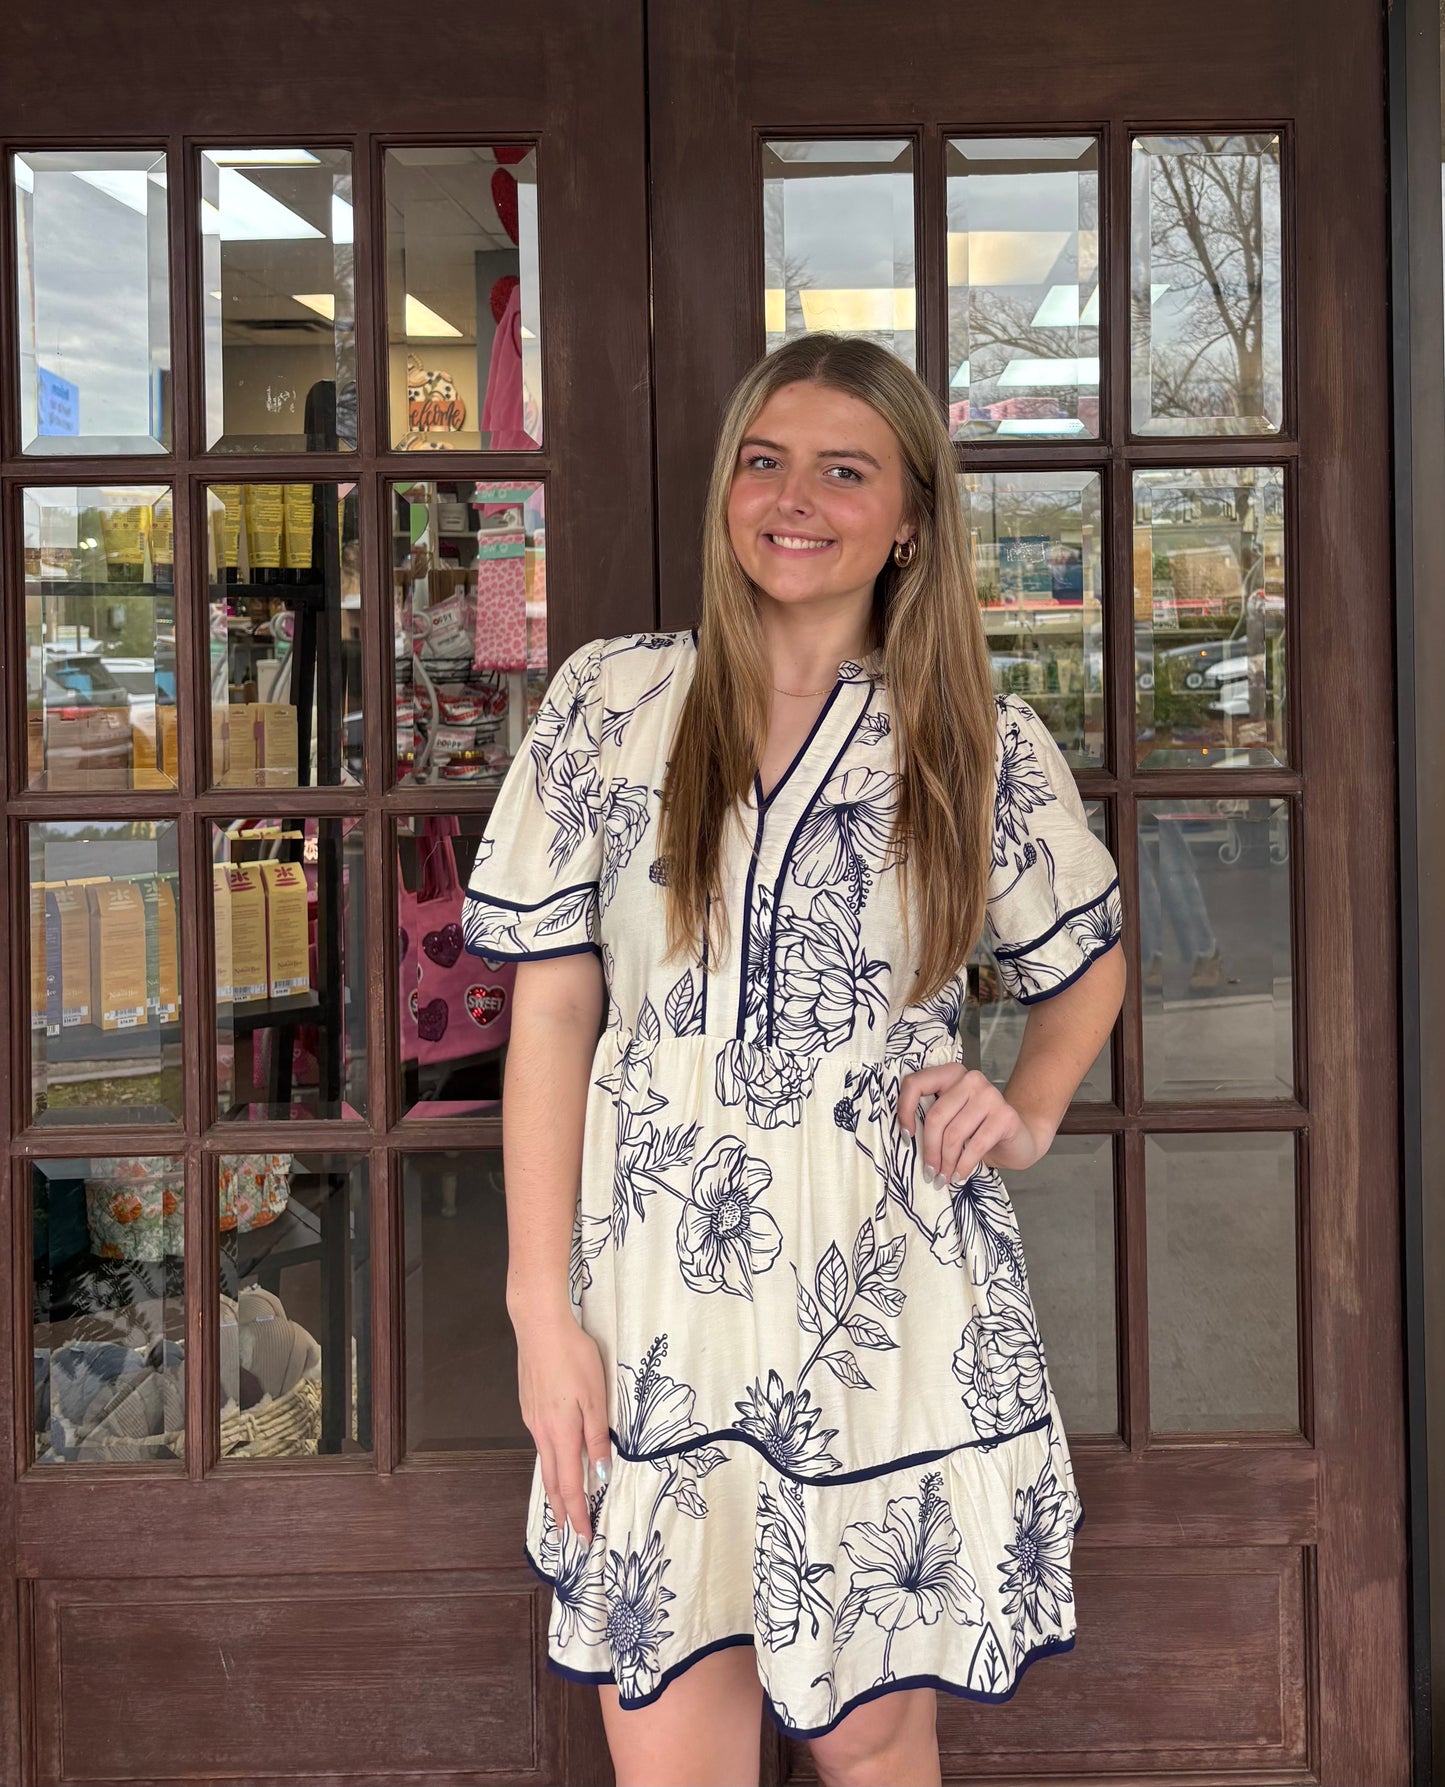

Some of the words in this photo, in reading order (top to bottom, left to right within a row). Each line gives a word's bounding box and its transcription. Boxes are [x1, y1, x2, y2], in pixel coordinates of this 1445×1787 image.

[409, 400, 461, 431] elcome
[433, 613, 452, 625] OPPY
[469, 996, 503, 1011] SWEET
